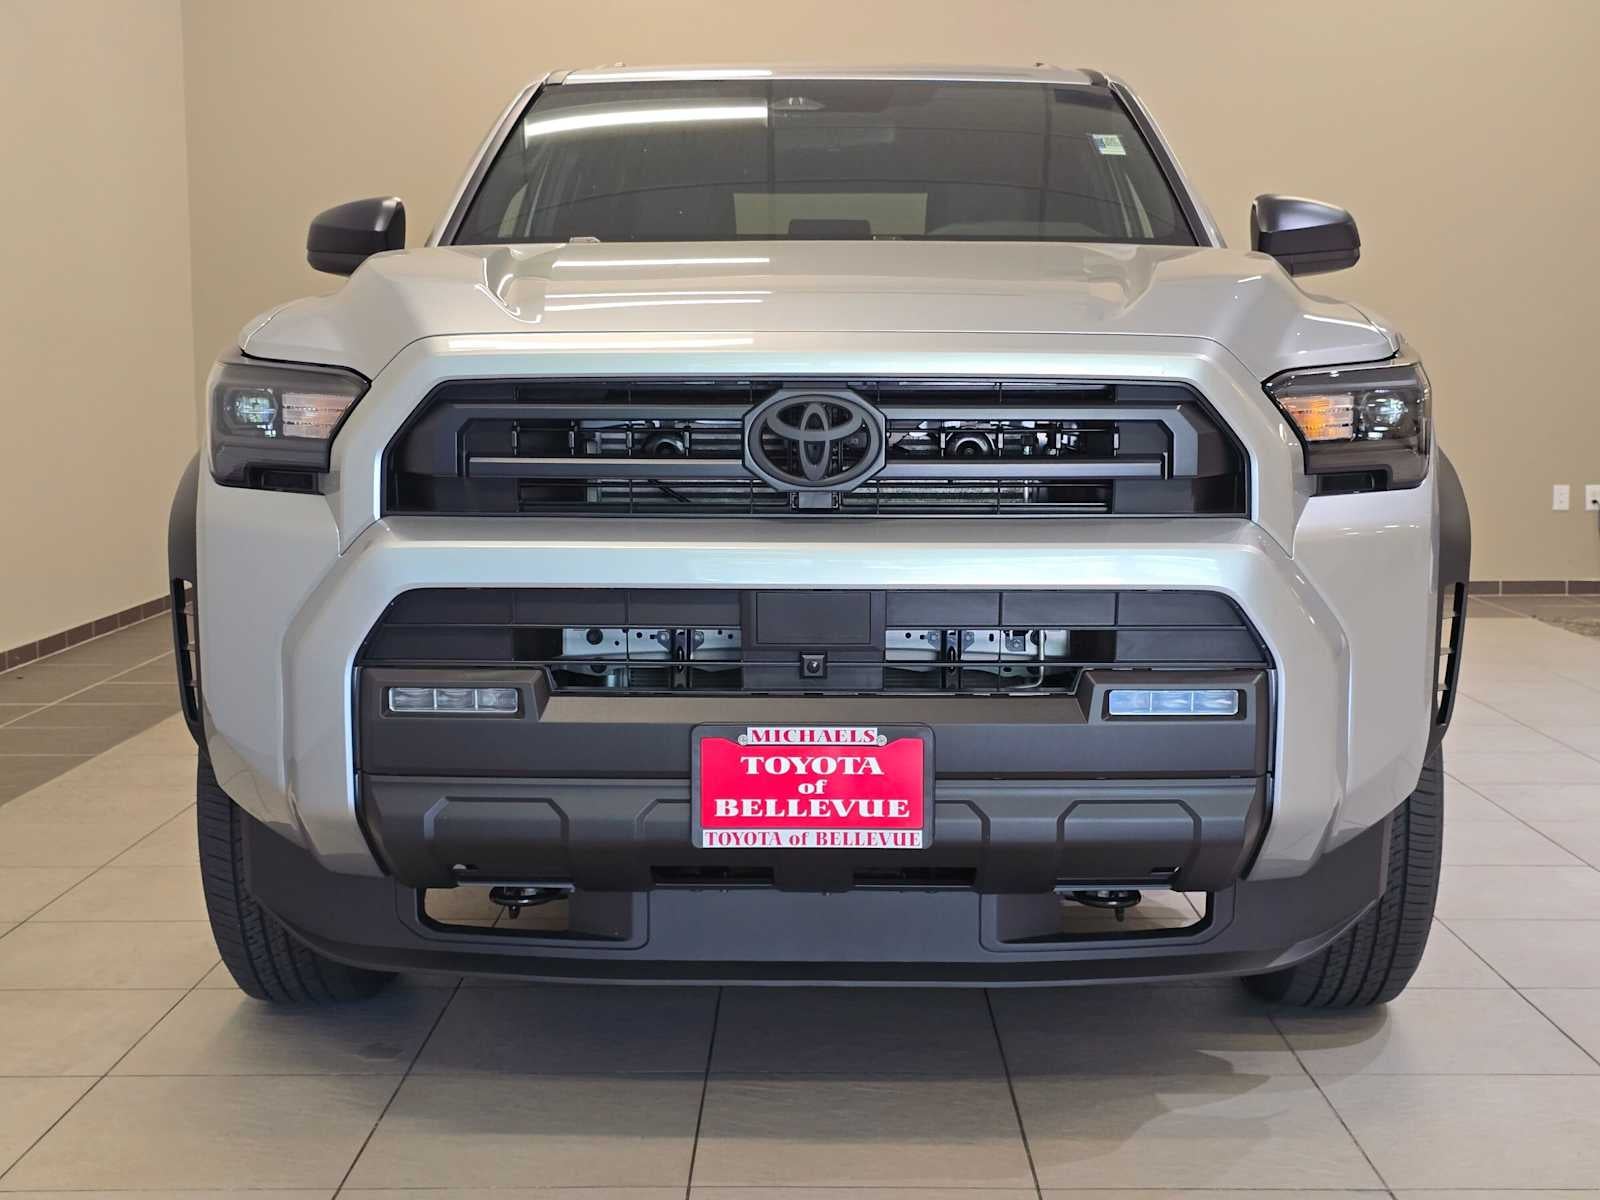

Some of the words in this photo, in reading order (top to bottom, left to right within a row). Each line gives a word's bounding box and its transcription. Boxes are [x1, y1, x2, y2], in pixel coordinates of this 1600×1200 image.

[751, 729, 876, 743] MICHAELS
[740, 756, 884, 775] TOYOTA
[798, 780, 828, 795] of
[714, 798, 910, 817] BELLEVUE
[705, 831, 783, 846] TOYOTA
[789, 831, 809, 846] of
[816, 831, 920, 846] BELLEVUE
